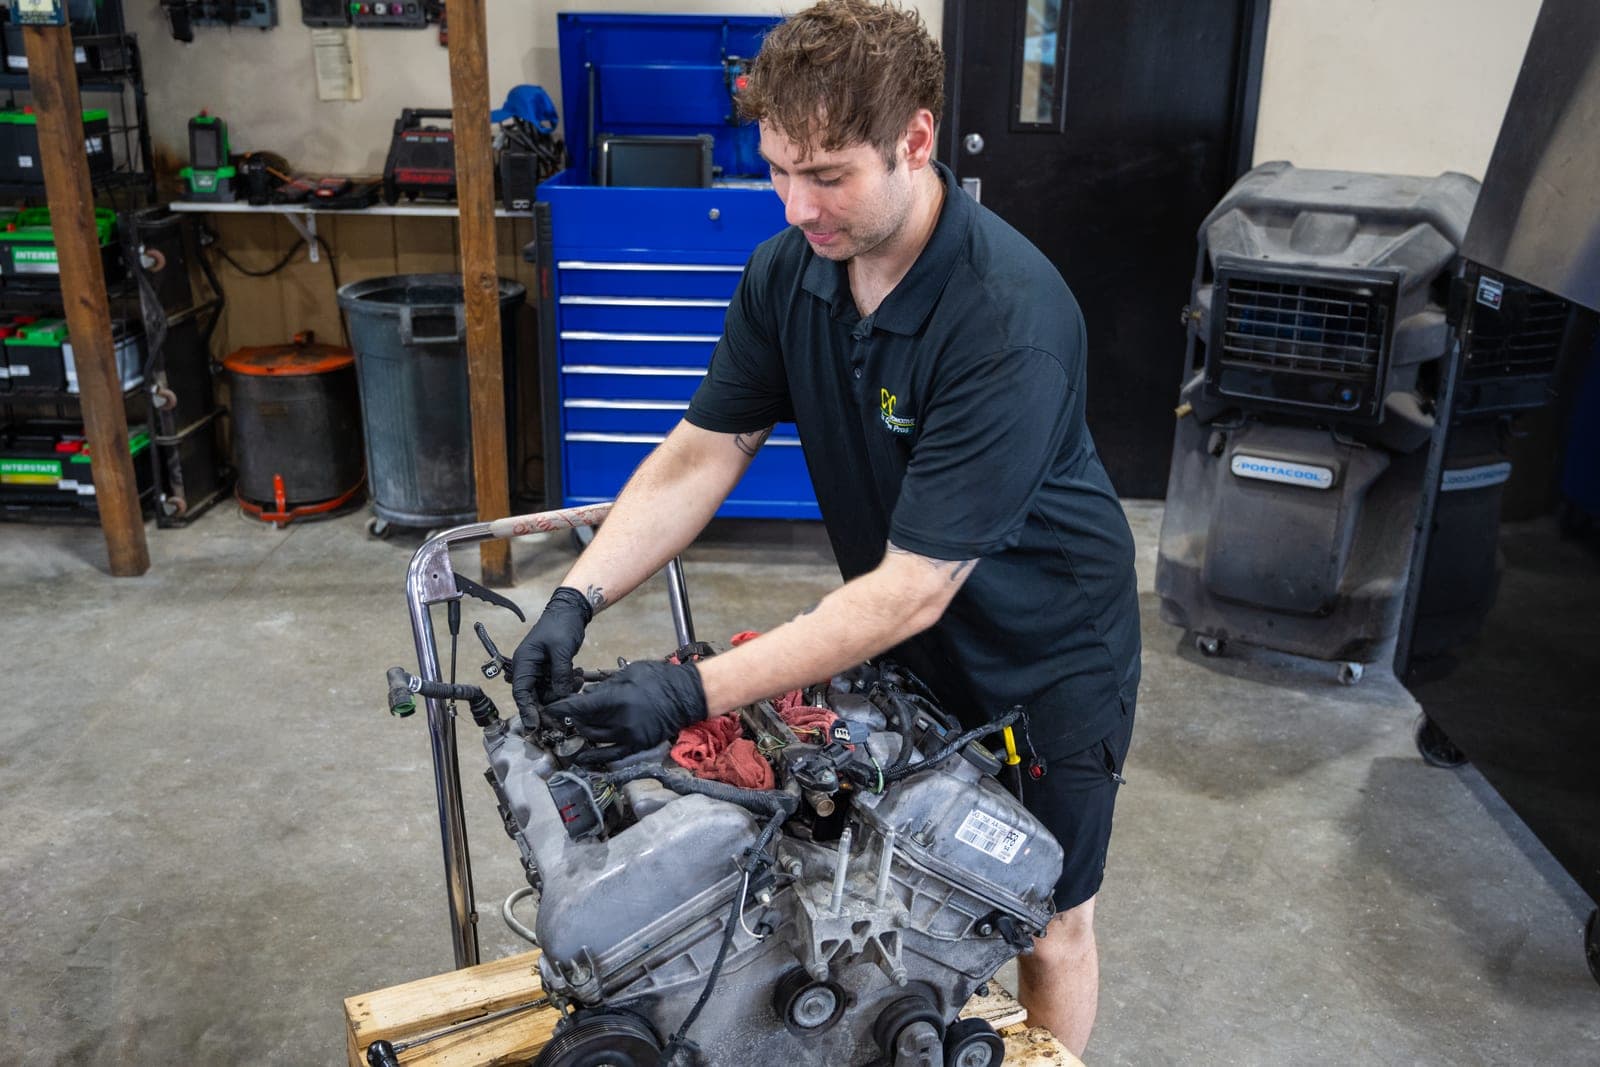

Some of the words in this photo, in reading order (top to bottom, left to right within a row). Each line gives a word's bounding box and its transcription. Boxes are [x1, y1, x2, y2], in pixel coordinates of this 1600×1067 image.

[15, 251, 58, 260] INTERST
[1, 463, 58, 472] INTERSTATE
[1241, 462, 1322, 481] PORTACOOL
